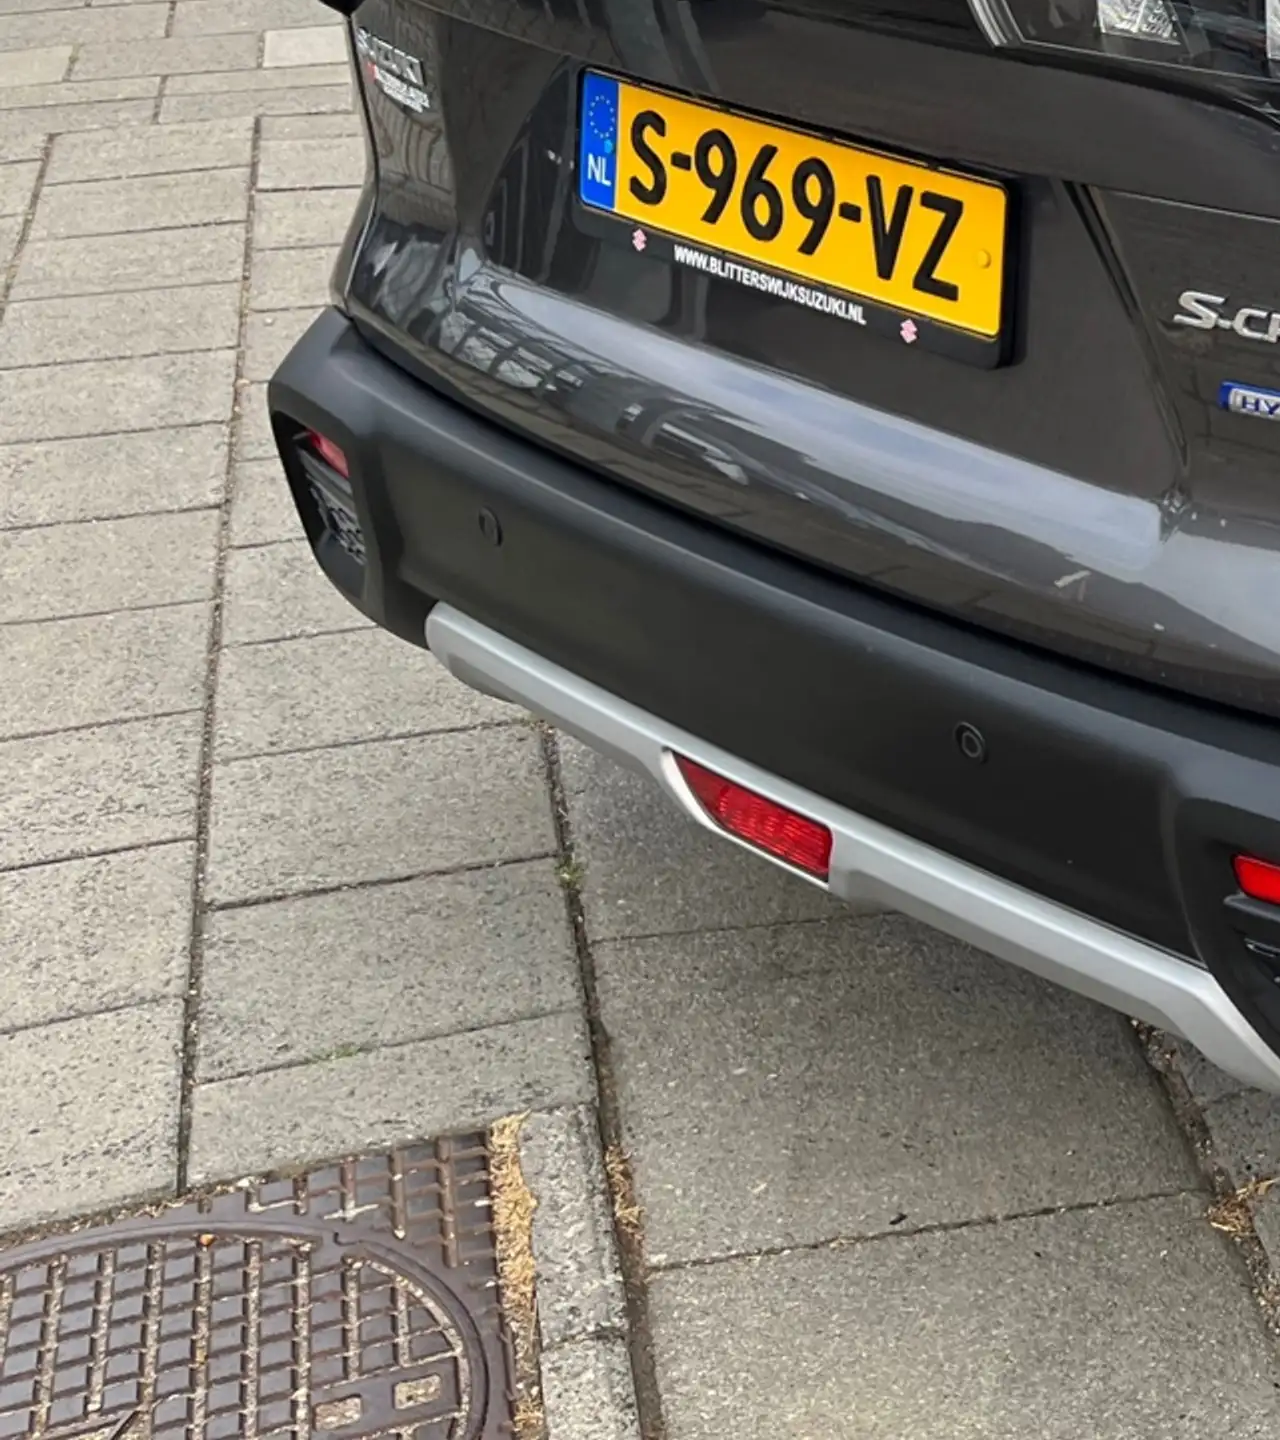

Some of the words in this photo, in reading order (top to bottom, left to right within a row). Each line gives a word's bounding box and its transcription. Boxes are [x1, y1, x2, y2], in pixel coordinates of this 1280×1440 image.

[587, 153, 612, 187] NL
[629, 110, 964, 302] S-969-VZ
[674, 244, 867, 325] WWW.BLITTERSWIJKSUZUKI.NL
